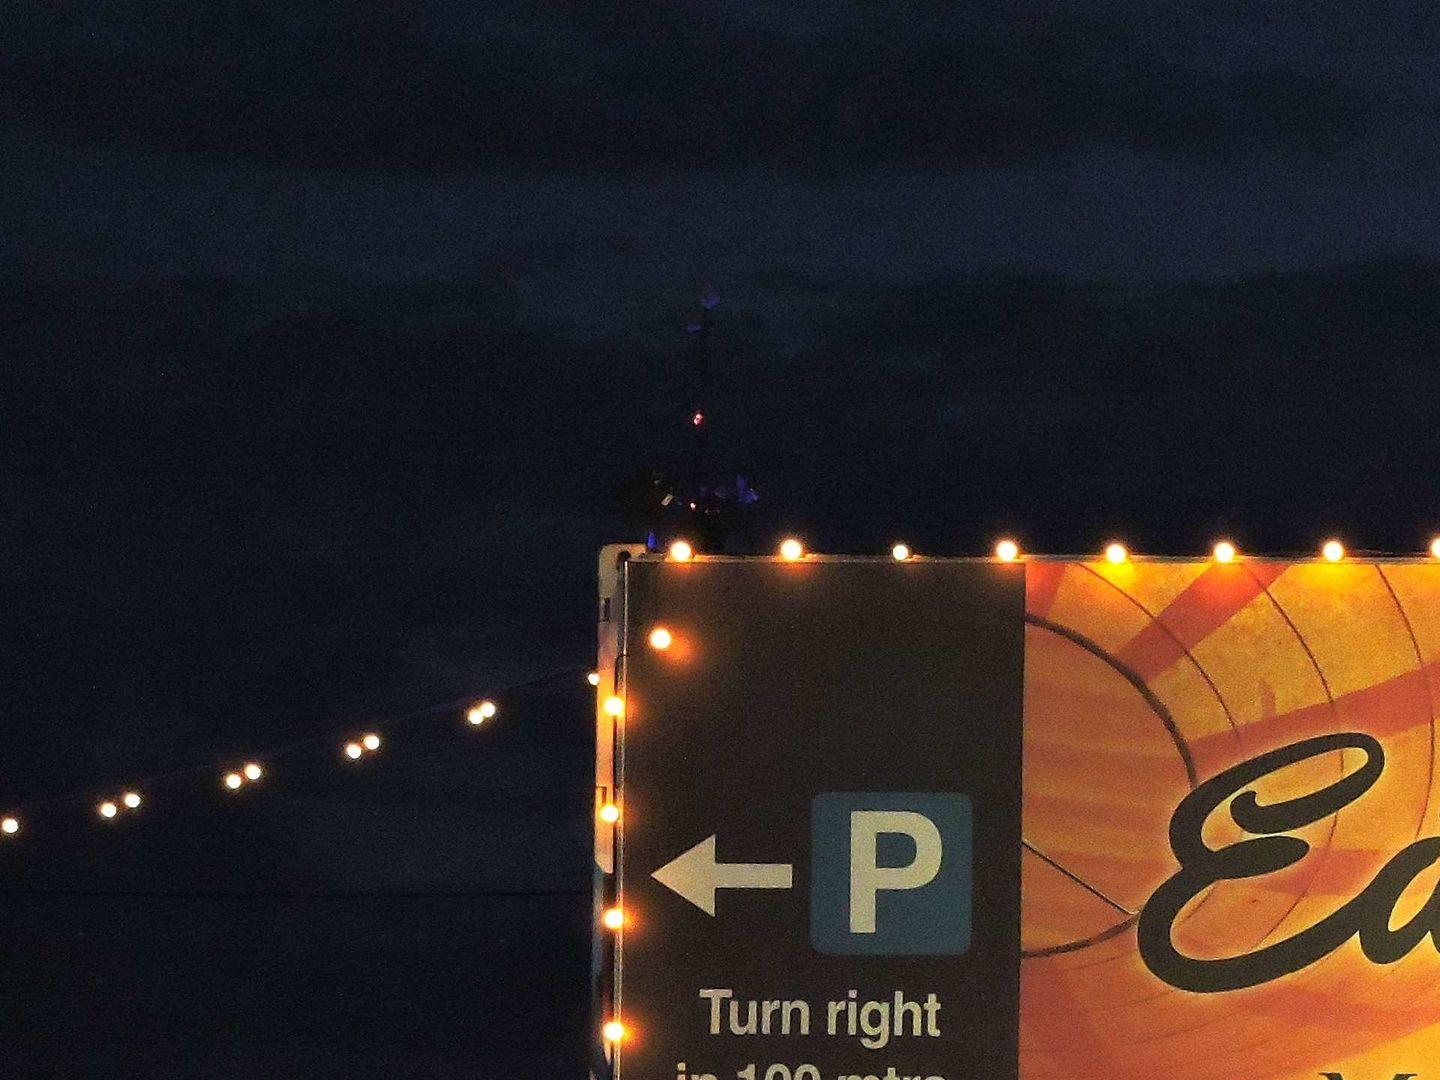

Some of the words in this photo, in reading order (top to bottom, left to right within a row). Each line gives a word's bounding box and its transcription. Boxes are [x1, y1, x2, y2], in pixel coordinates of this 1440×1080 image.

[849, 810, 943, 934] P
[699, 988, 810, 1036] Turn
[827, 989, 942, 1050] right
